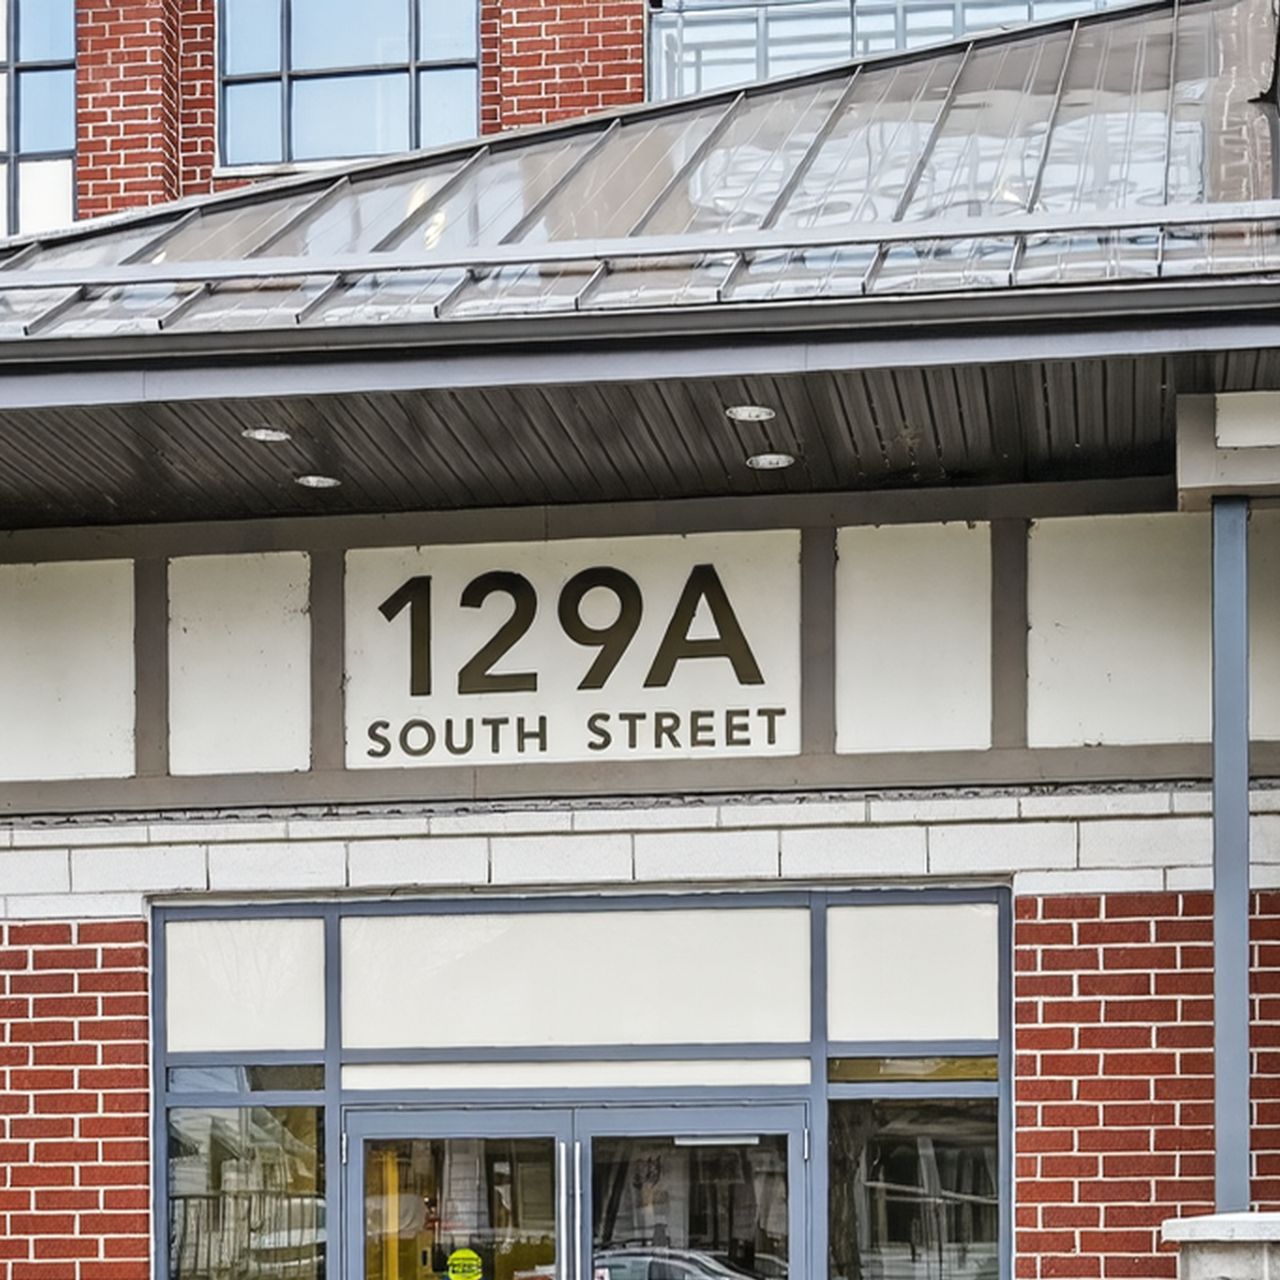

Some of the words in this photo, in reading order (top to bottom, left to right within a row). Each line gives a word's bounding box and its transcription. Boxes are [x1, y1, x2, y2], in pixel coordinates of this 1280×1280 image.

[378, 564, 765, 697] 129A
[367, 715, 548, 758] SOUTH
[587, 707, 787, 750] STREET
